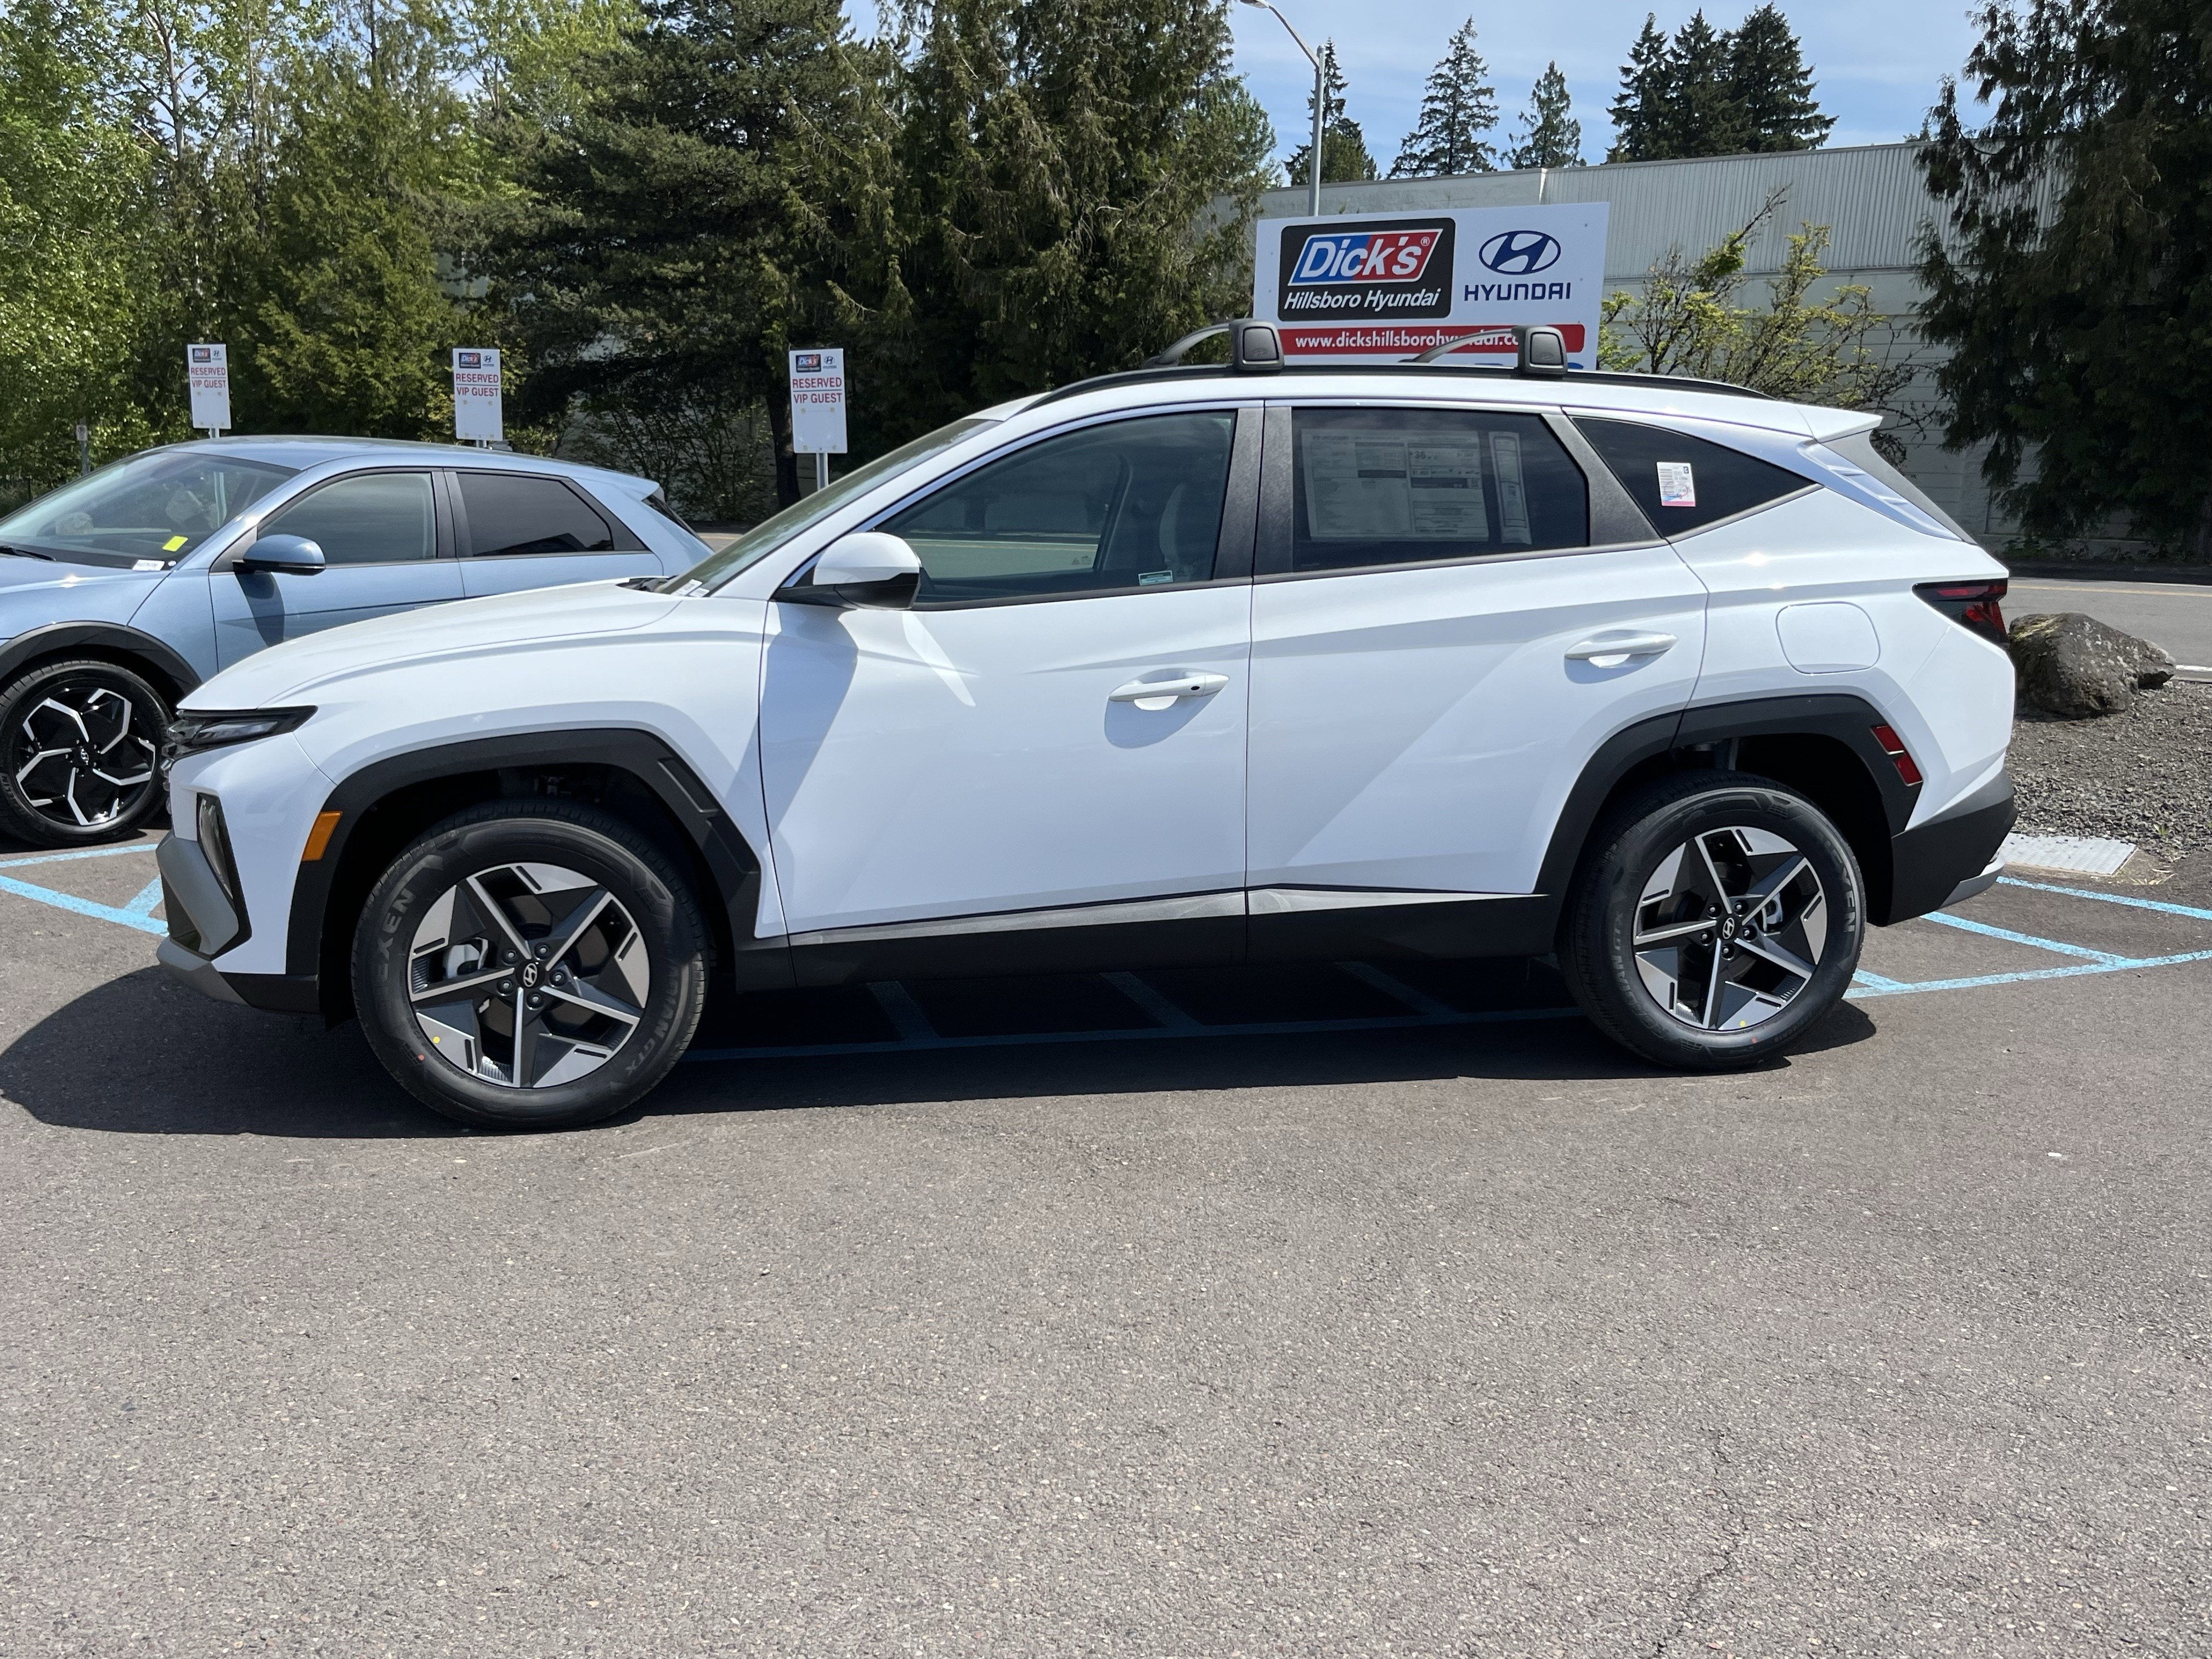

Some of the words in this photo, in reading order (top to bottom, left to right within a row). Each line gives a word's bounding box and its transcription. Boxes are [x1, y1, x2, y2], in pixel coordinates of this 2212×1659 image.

[1464, 282, 1571, 301] HYUNDAI
[1284, 291, 1362, 310] Hillsboro
[1363, 287, 1442, 312] Hyundai
[190, 367, 226, 376] RESERVED
[455, 373, 499, 383] RESERVED
[792, 377, 842, 389] RESERVED
[191, 380, 202, 388] VIP
[204, 380, 227, 388] GUEST
[456, 387, 469, 396] VIP
[472, 387, 499, 397] GUEST
[793, 394, 808, 404] VIP
[811, 393, 842, 403] GUEST
